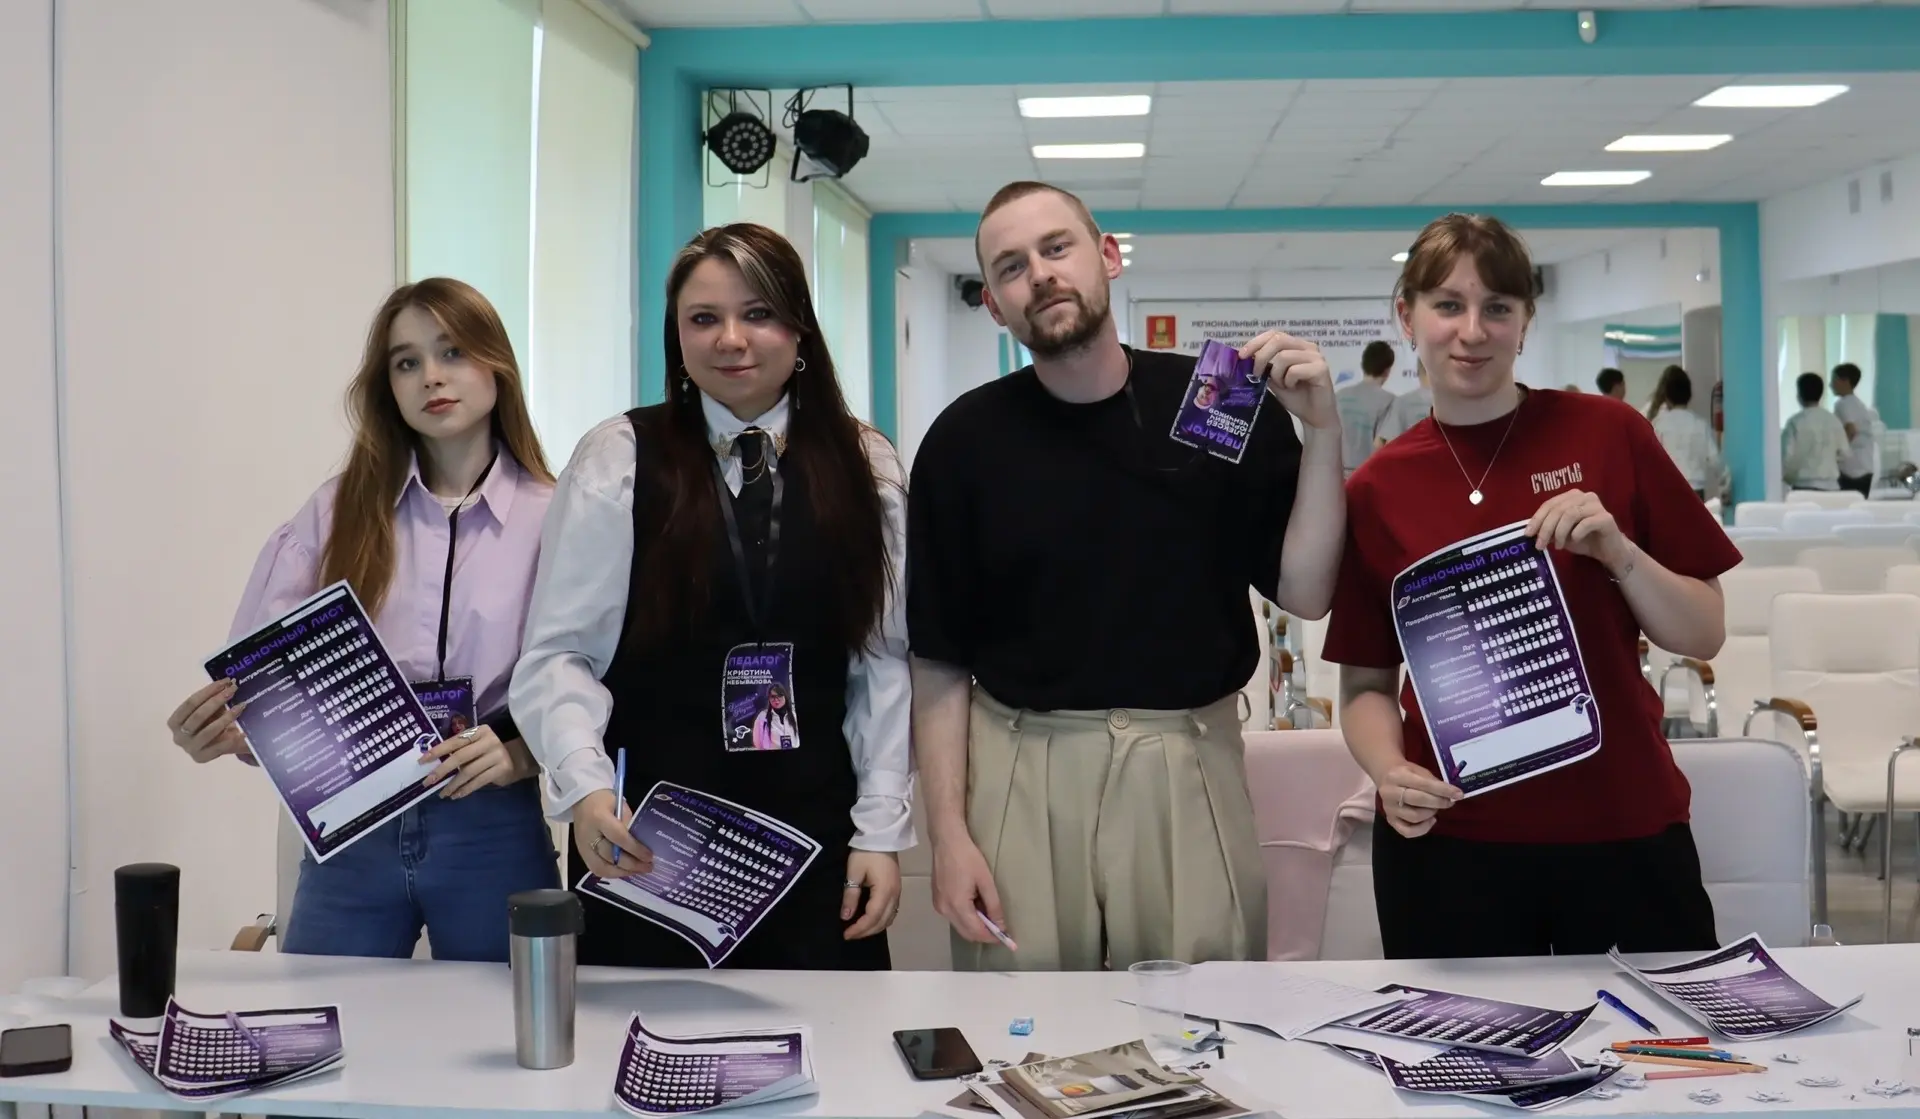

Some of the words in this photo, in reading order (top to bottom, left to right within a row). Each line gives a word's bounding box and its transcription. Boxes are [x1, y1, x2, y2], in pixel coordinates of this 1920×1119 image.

[1191, 318, 1259, 328] РЕГИОНАЛЬНЫЙ
[1260, 319, 1287, 329] ЦЕНТР
[1343, 318, 1385, 327] РАЗВИТИЯ
[1203, 330, 1256, 339] ПОДДЕРЖКИ
[1329, 329, 1336, 337] И
[1338, 329, 1382, 337] ТАЛАНТОВ
[1321, 340, 1362, 348] ОБЛАСТИ
[1187, 422, 1243, 451] ПЕДАГОГ
[1206, 419, 1246, 437] АЛЕКСЕЙ
[1403, 554, 1486, 593] ОЦЕНОЧНЫЙ
[1490, 542, 1527, 563] ЛИСТ
[1411, 585, 1456, 604] Актуальность
[1405, 604, 1462, 627] Проработанность
[225, 623, 308, 677] ОЦЕНОЧНЫЙ
[311, 603, 345, 629] ЛИСТ
[1426, 624, 1469, 643] Доступность
[1462, 643, 1476, 652] Дух
[729, 655, 780, 667] ПЕДАГОГ
[417, 689, 464, 702] ЕДАГОГ
[669, 791, 759, 833] ОЦЕНОЧНЫЙ
[761, 830, 799, 852] ЛИСТ
